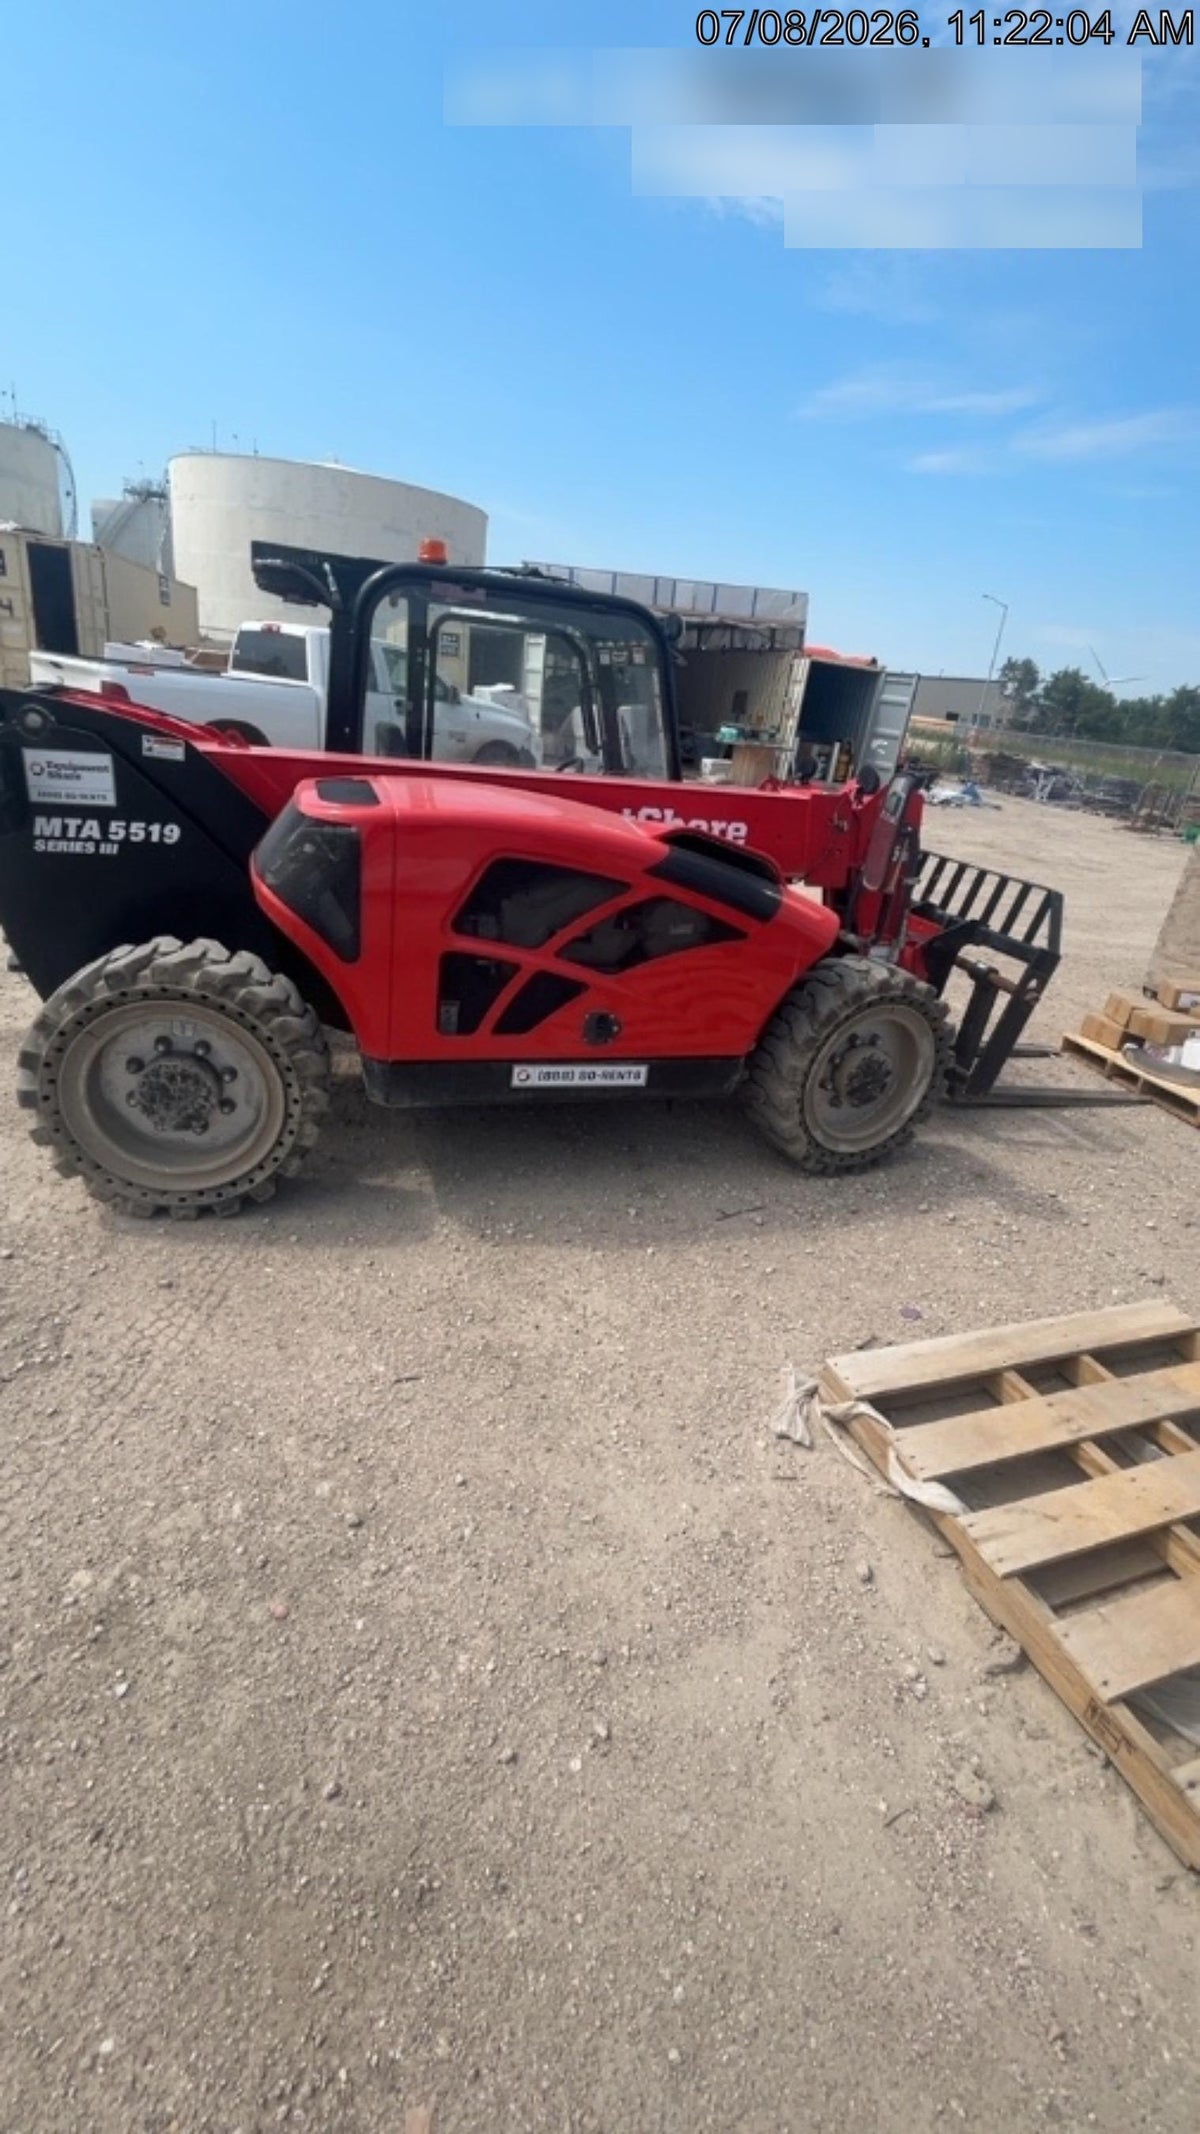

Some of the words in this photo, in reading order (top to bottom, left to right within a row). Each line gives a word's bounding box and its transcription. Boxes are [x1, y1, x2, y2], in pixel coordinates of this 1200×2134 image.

[33, 816, 101, 840] MTA
[108, 820, 181, 845] 5519
[34, 838, 96, 855] SERIES
[99, 841, 120, 855] III
